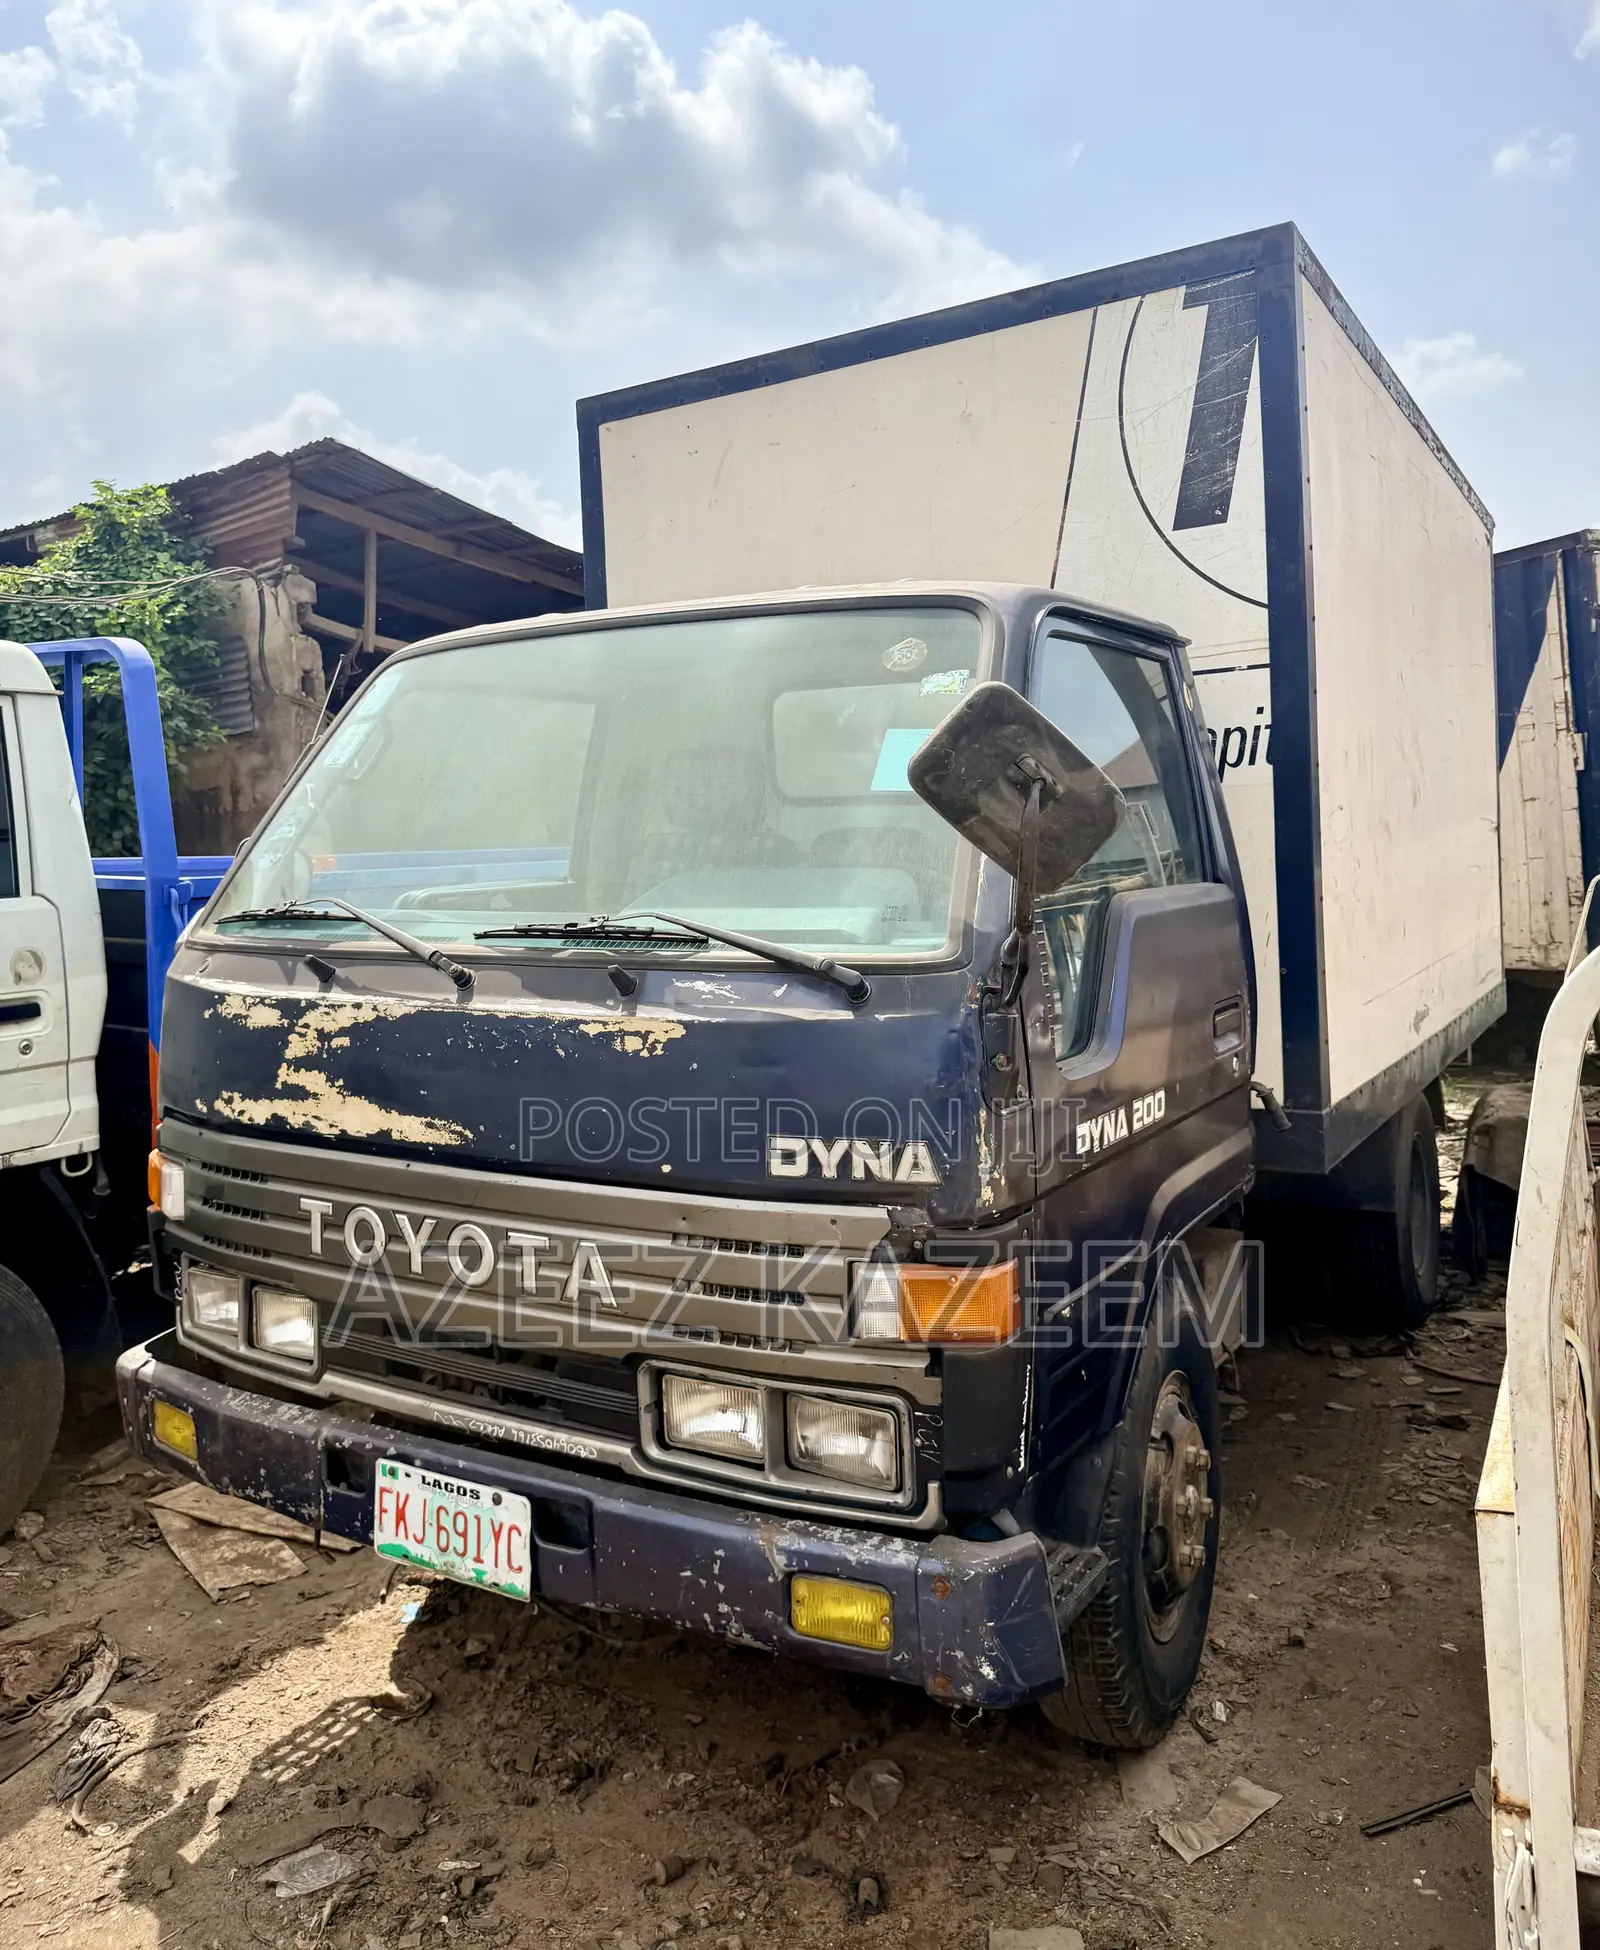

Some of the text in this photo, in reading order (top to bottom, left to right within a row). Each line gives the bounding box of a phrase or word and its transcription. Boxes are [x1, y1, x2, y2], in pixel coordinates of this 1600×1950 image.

[1075, 1086, 1166, 1155] DYNA 200
[767, 1136, 942, 1185] DYNA
[299, 1197, 618, 1308] TOYOTA
[420, 1474, 481, 1500] LAGOS
